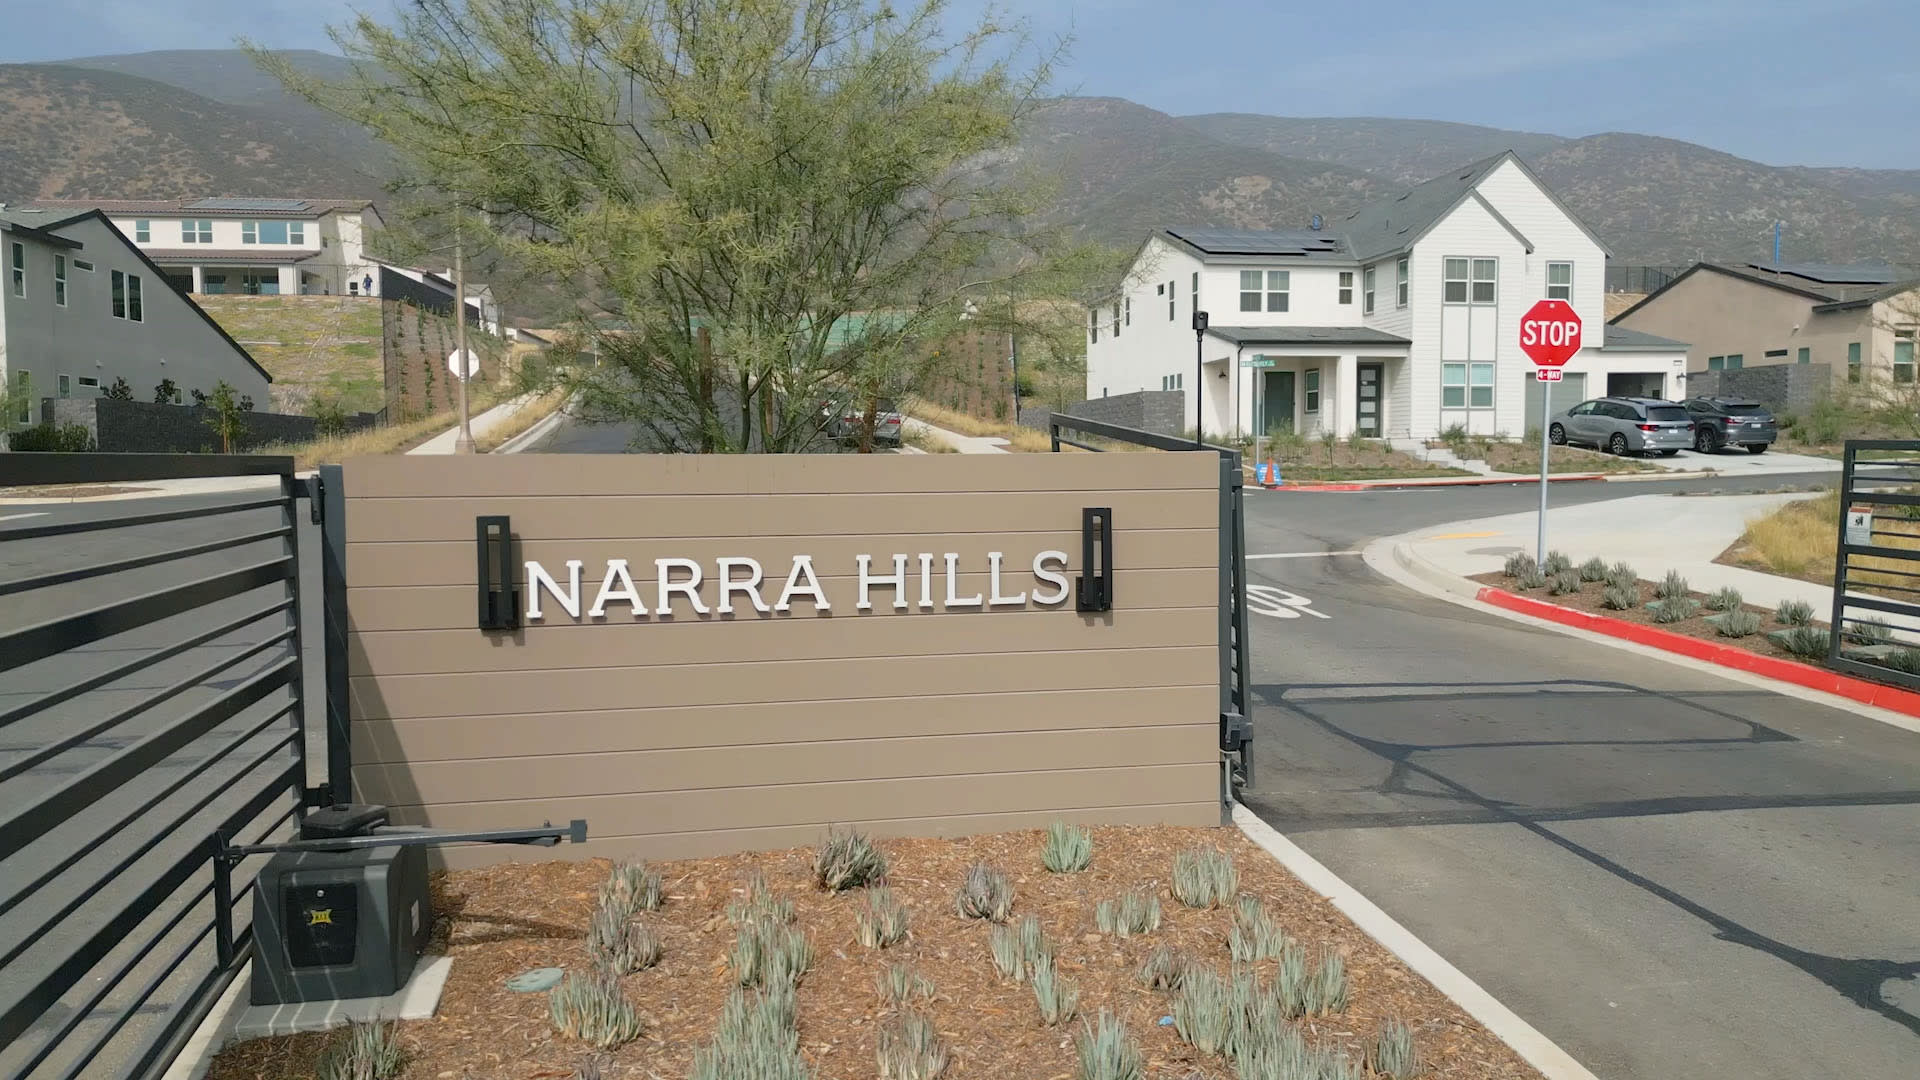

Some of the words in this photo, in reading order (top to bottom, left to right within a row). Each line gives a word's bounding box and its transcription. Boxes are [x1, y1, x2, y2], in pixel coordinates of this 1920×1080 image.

[1522, 320, 1579, 346] STOP
[1537, 370, 1561, 380] 4-WAY
[524, 555, 831, 619] NARRA
[855, 550, 1070, 609] HILLS
